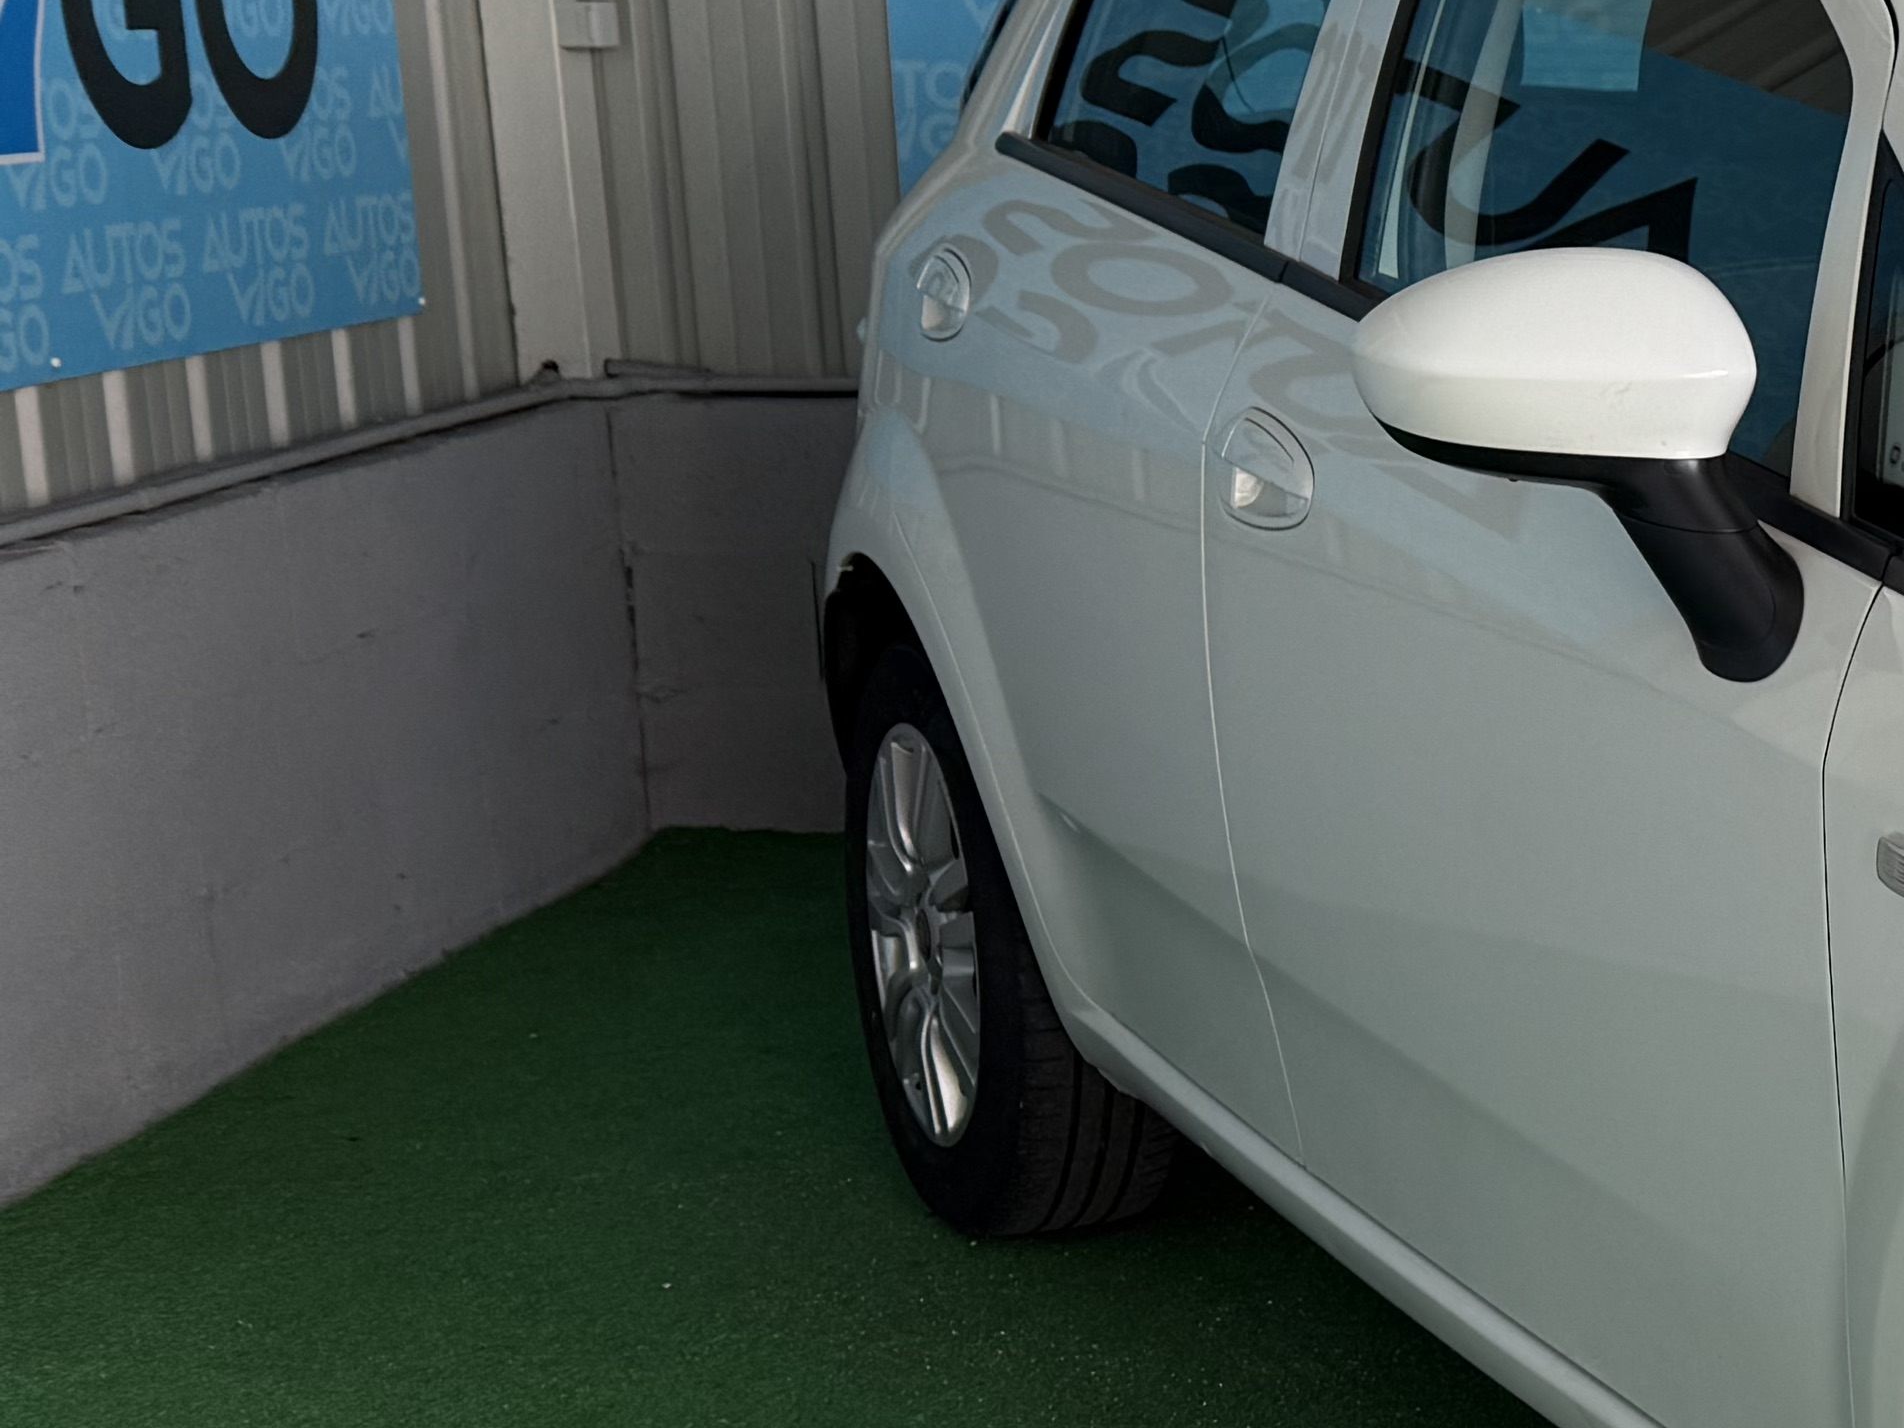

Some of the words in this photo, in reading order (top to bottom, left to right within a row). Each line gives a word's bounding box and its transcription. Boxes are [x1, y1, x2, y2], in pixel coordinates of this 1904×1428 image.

[61, 216, 187, 295] AUTOS
[203, 203, 311, 274] AUTOS
[323, 192, 416, 256] AUTOS
